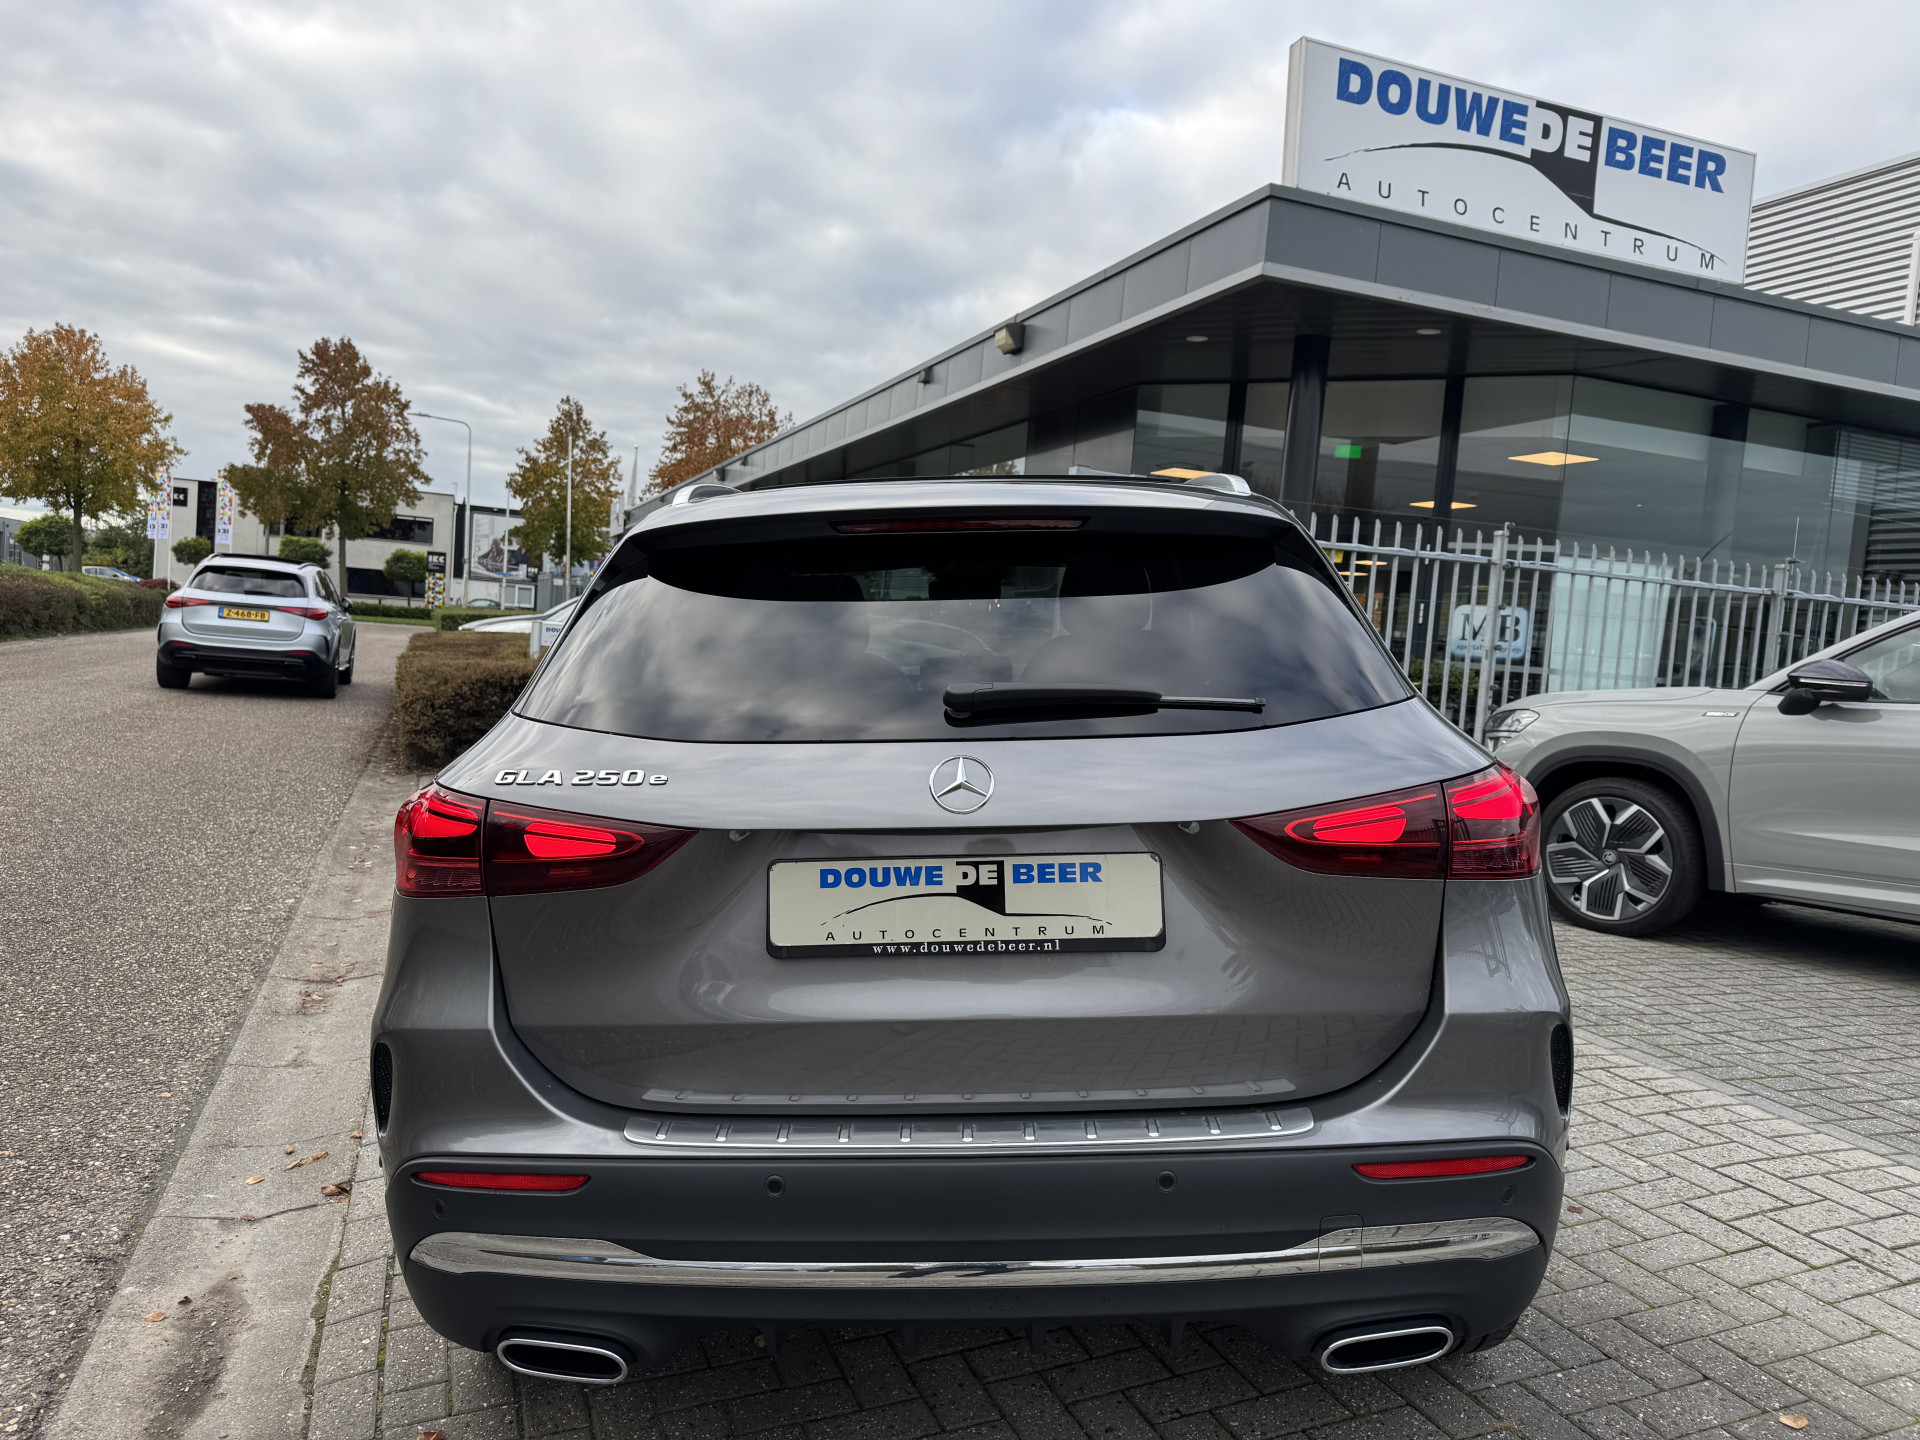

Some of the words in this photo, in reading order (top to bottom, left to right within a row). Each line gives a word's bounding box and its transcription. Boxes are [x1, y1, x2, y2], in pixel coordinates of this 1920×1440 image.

[1336, 57, 1530, 146] DOUWE
[1530, 104, 1595, 163] DE
[1604, 126, 1727, 194] BEER
[1336, 172, 1715, 271] AUTOCENTRUM
[494, 769, 563, 786] GLA
[819, 866, 944, 889] DOUWE
[956, 864, 999, 886] DE
[1012, 862, 1103, 884] BEER
[825, 925, 1105, 942] AUTOCENTRUM
[873, 940, 1061, 954] www.douwedebeer.nl
